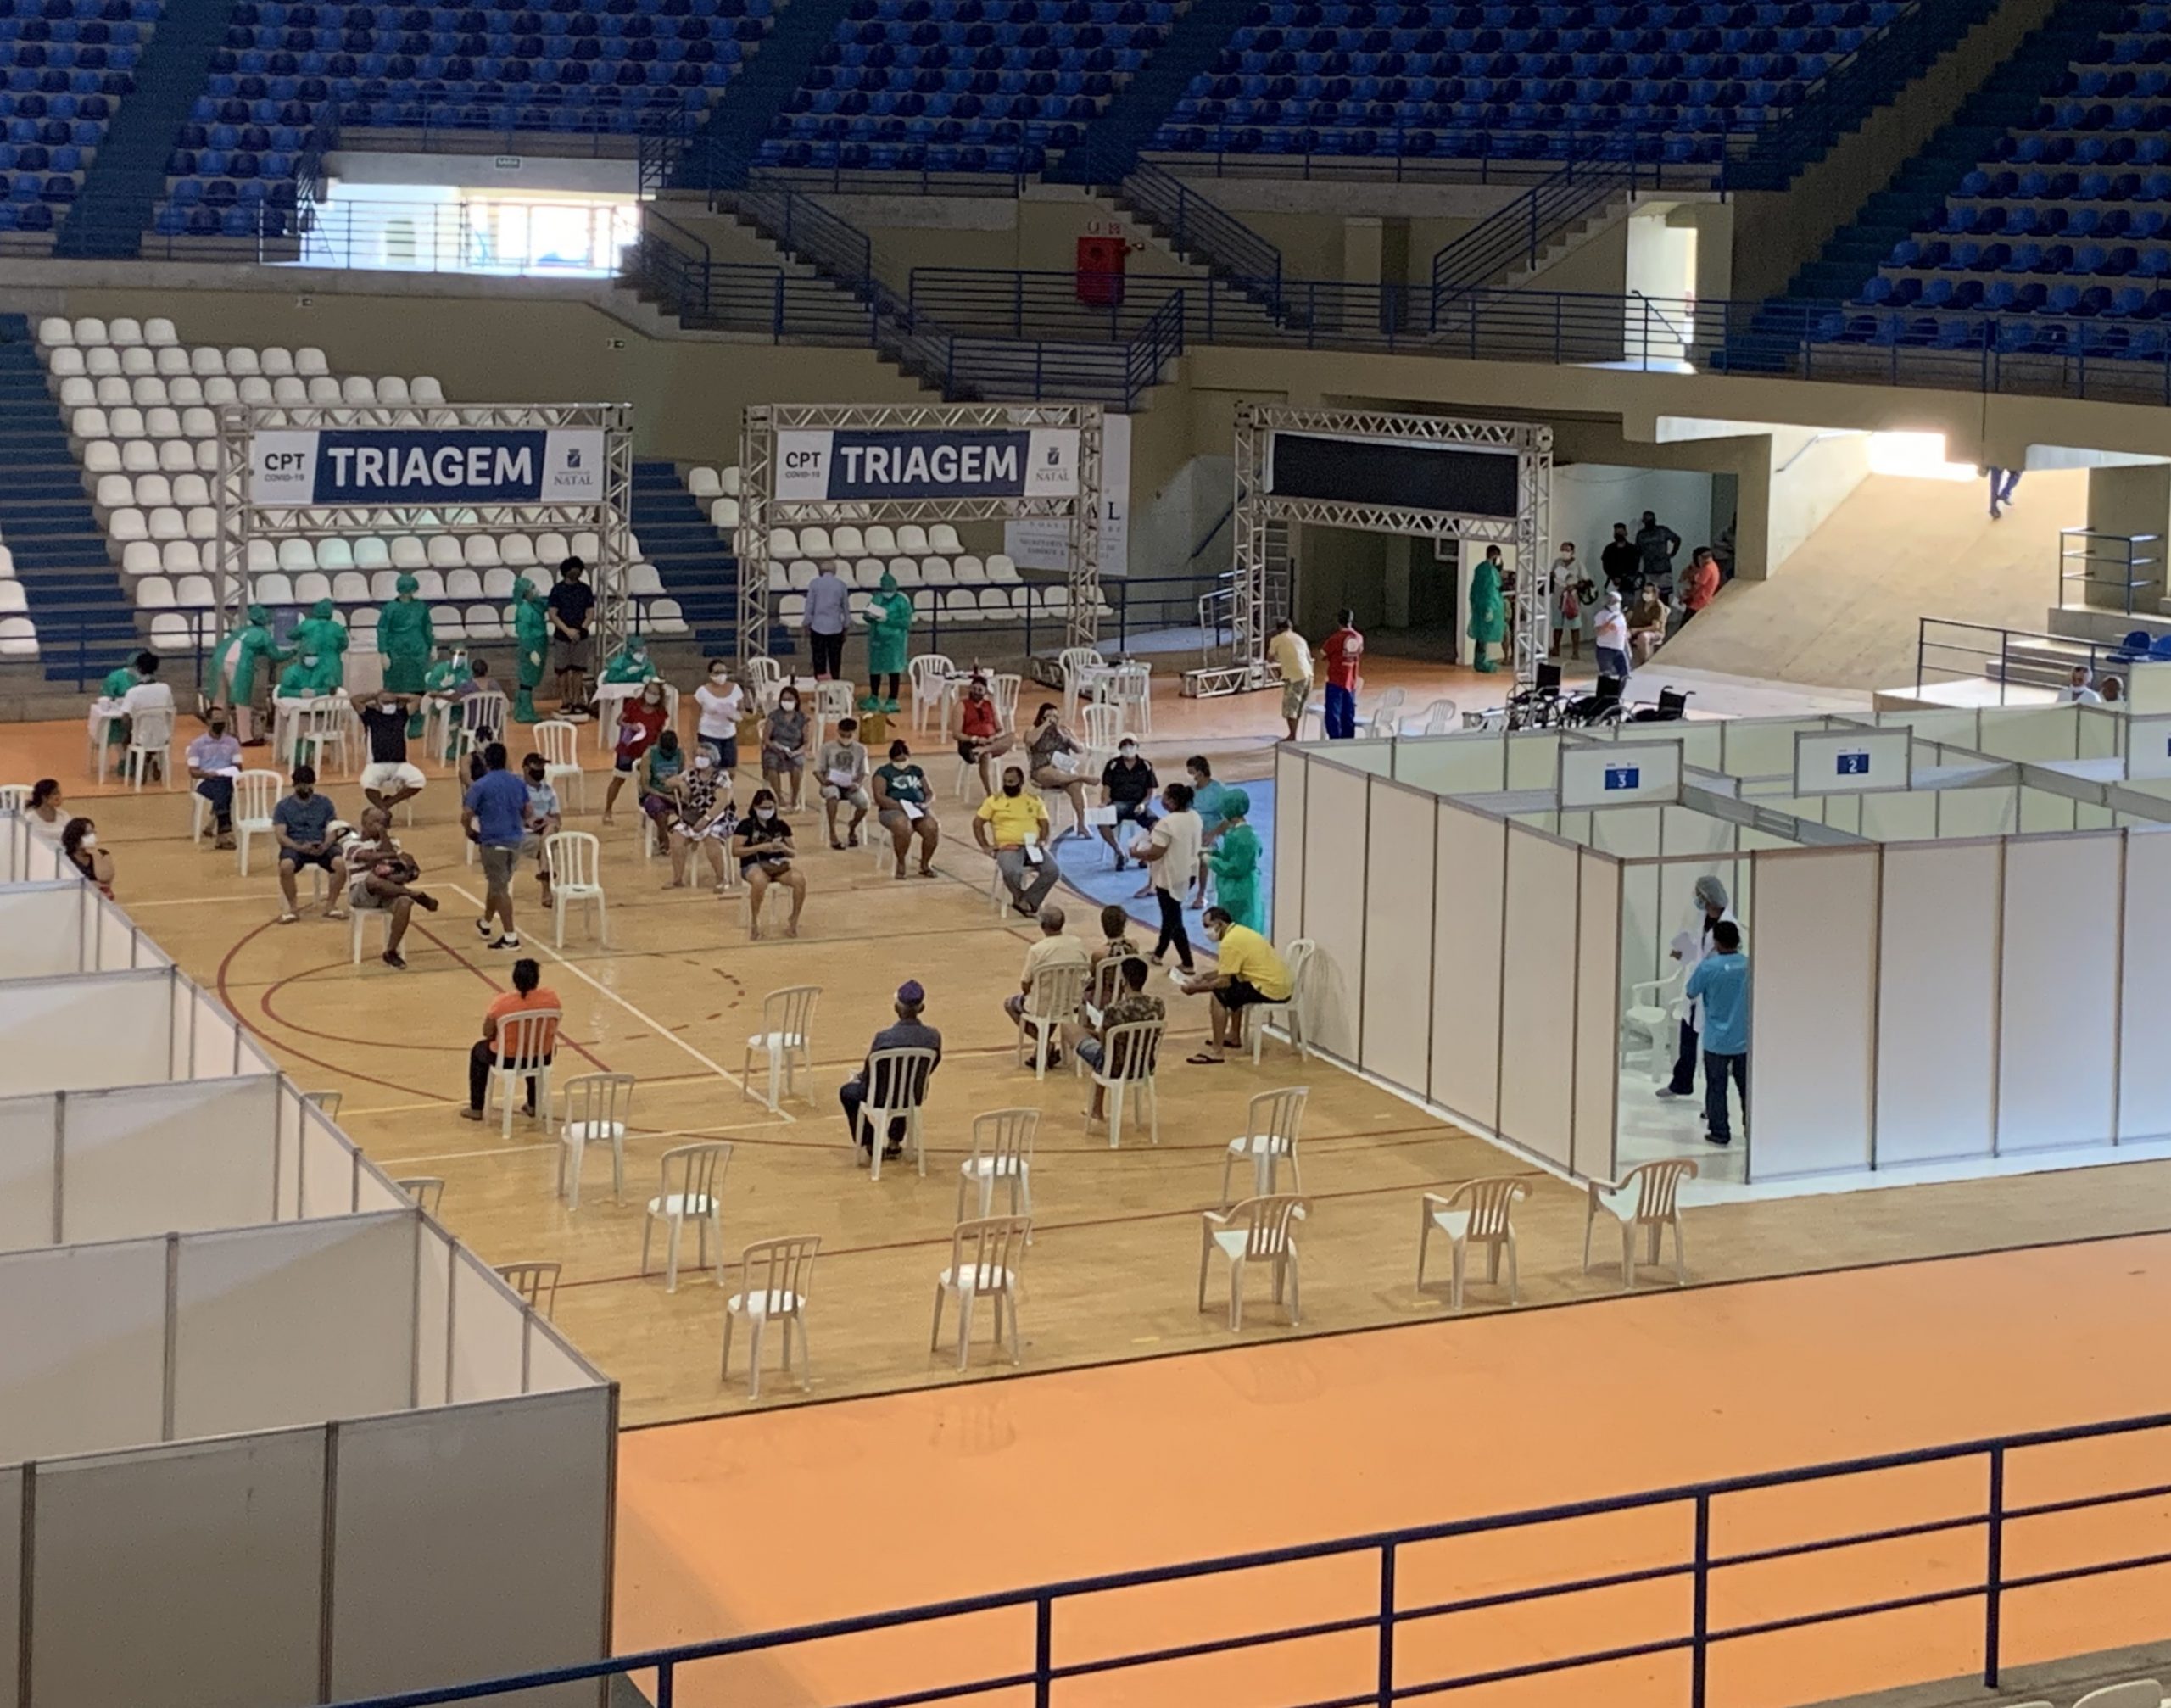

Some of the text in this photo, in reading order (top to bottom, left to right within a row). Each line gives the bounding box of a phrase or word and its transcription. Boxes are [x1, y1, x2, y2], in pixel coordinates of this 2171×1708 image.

[264, 453, 305, 471] CPT
[785, 451, 821, 468] CPT
[840, 445, 1018, 483] TRIAGEM
[327, 447, 533, 488] TRIAGEM
[554, 475, 594, 486] NATAL
[1035, 472, 1070, 482] NATAL
[1849, 759, 1857, 773] 2
[1618, 774, 1627, 788] 3
